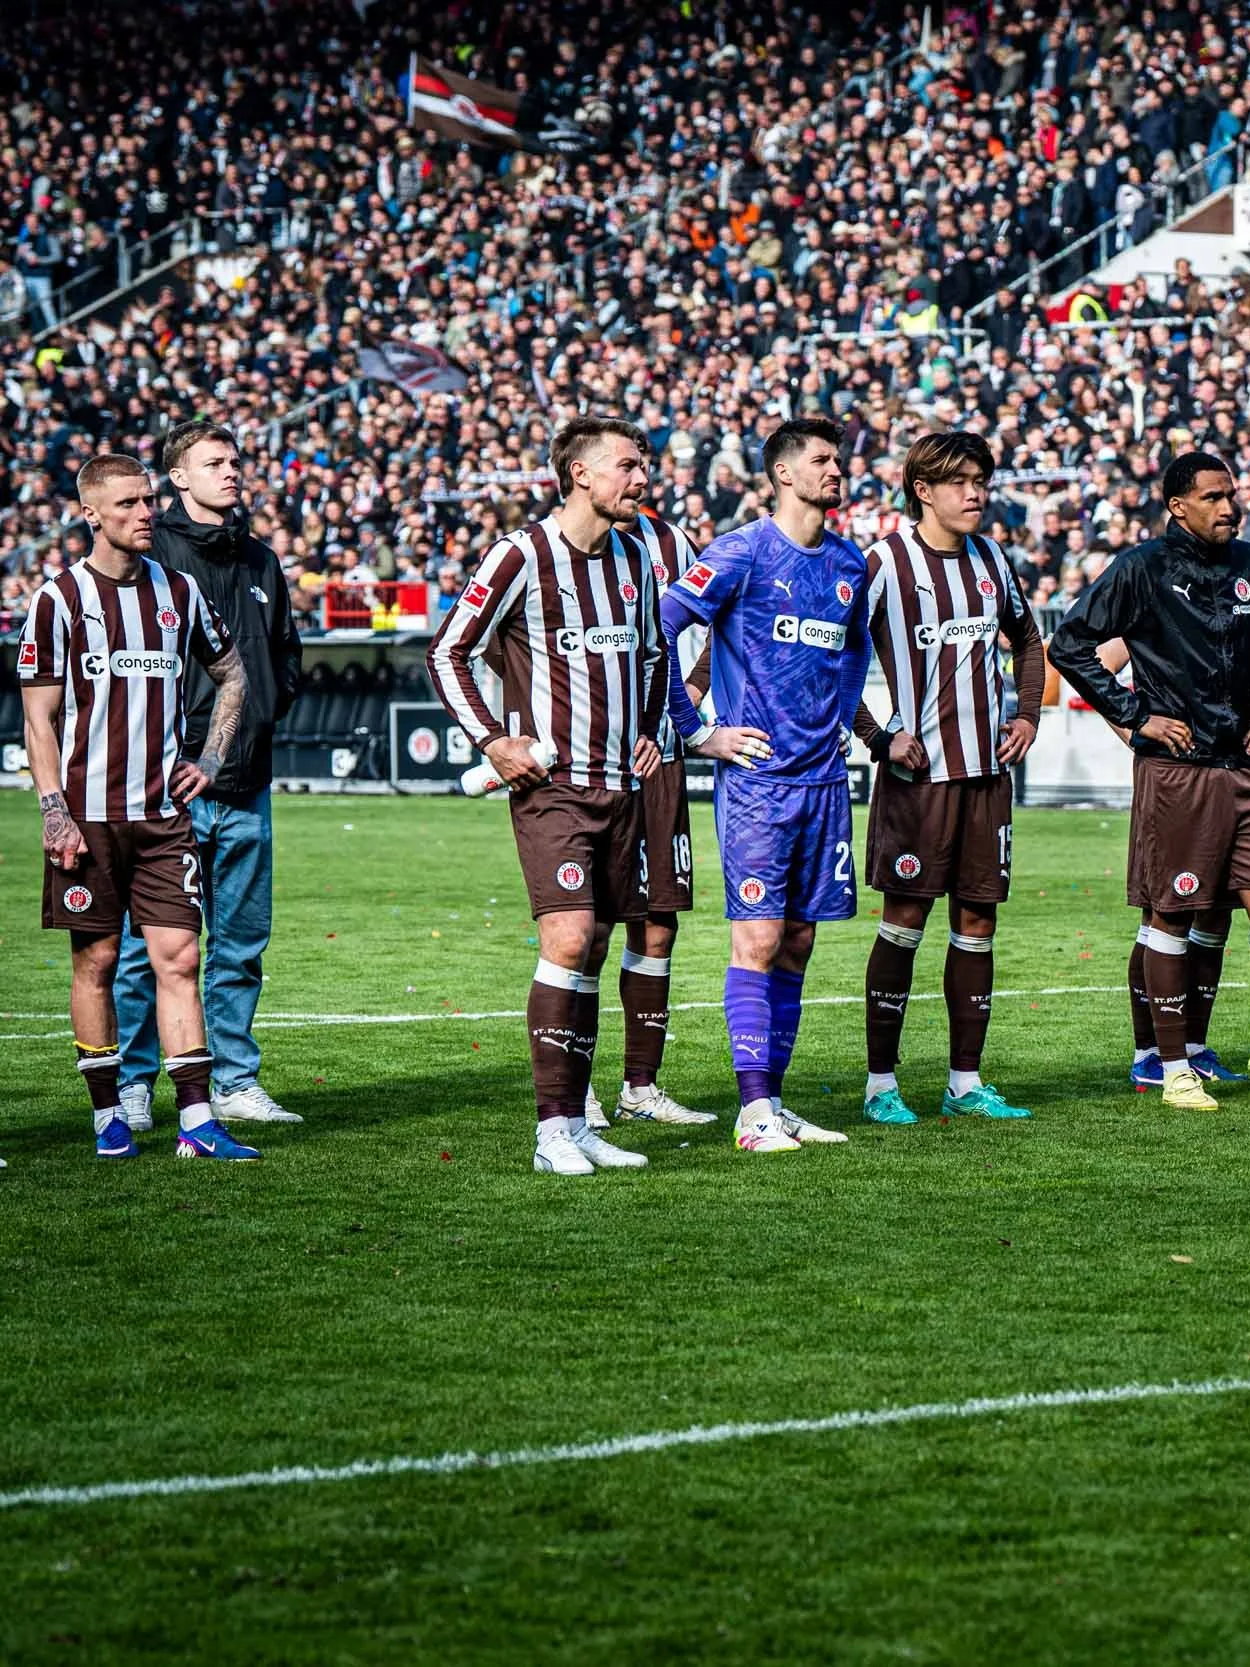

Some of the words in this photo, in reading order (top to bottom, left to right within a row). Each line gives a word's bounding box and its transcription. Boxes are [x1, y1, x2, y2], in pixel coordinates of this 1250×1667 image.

[946, 621, 998, 638] congstar
[117, 657, 177, 671] congstar
[181, 853, 203, 893] 2
[672, 833, 691, 874] 18
[834, 841, 852, 881] 2
